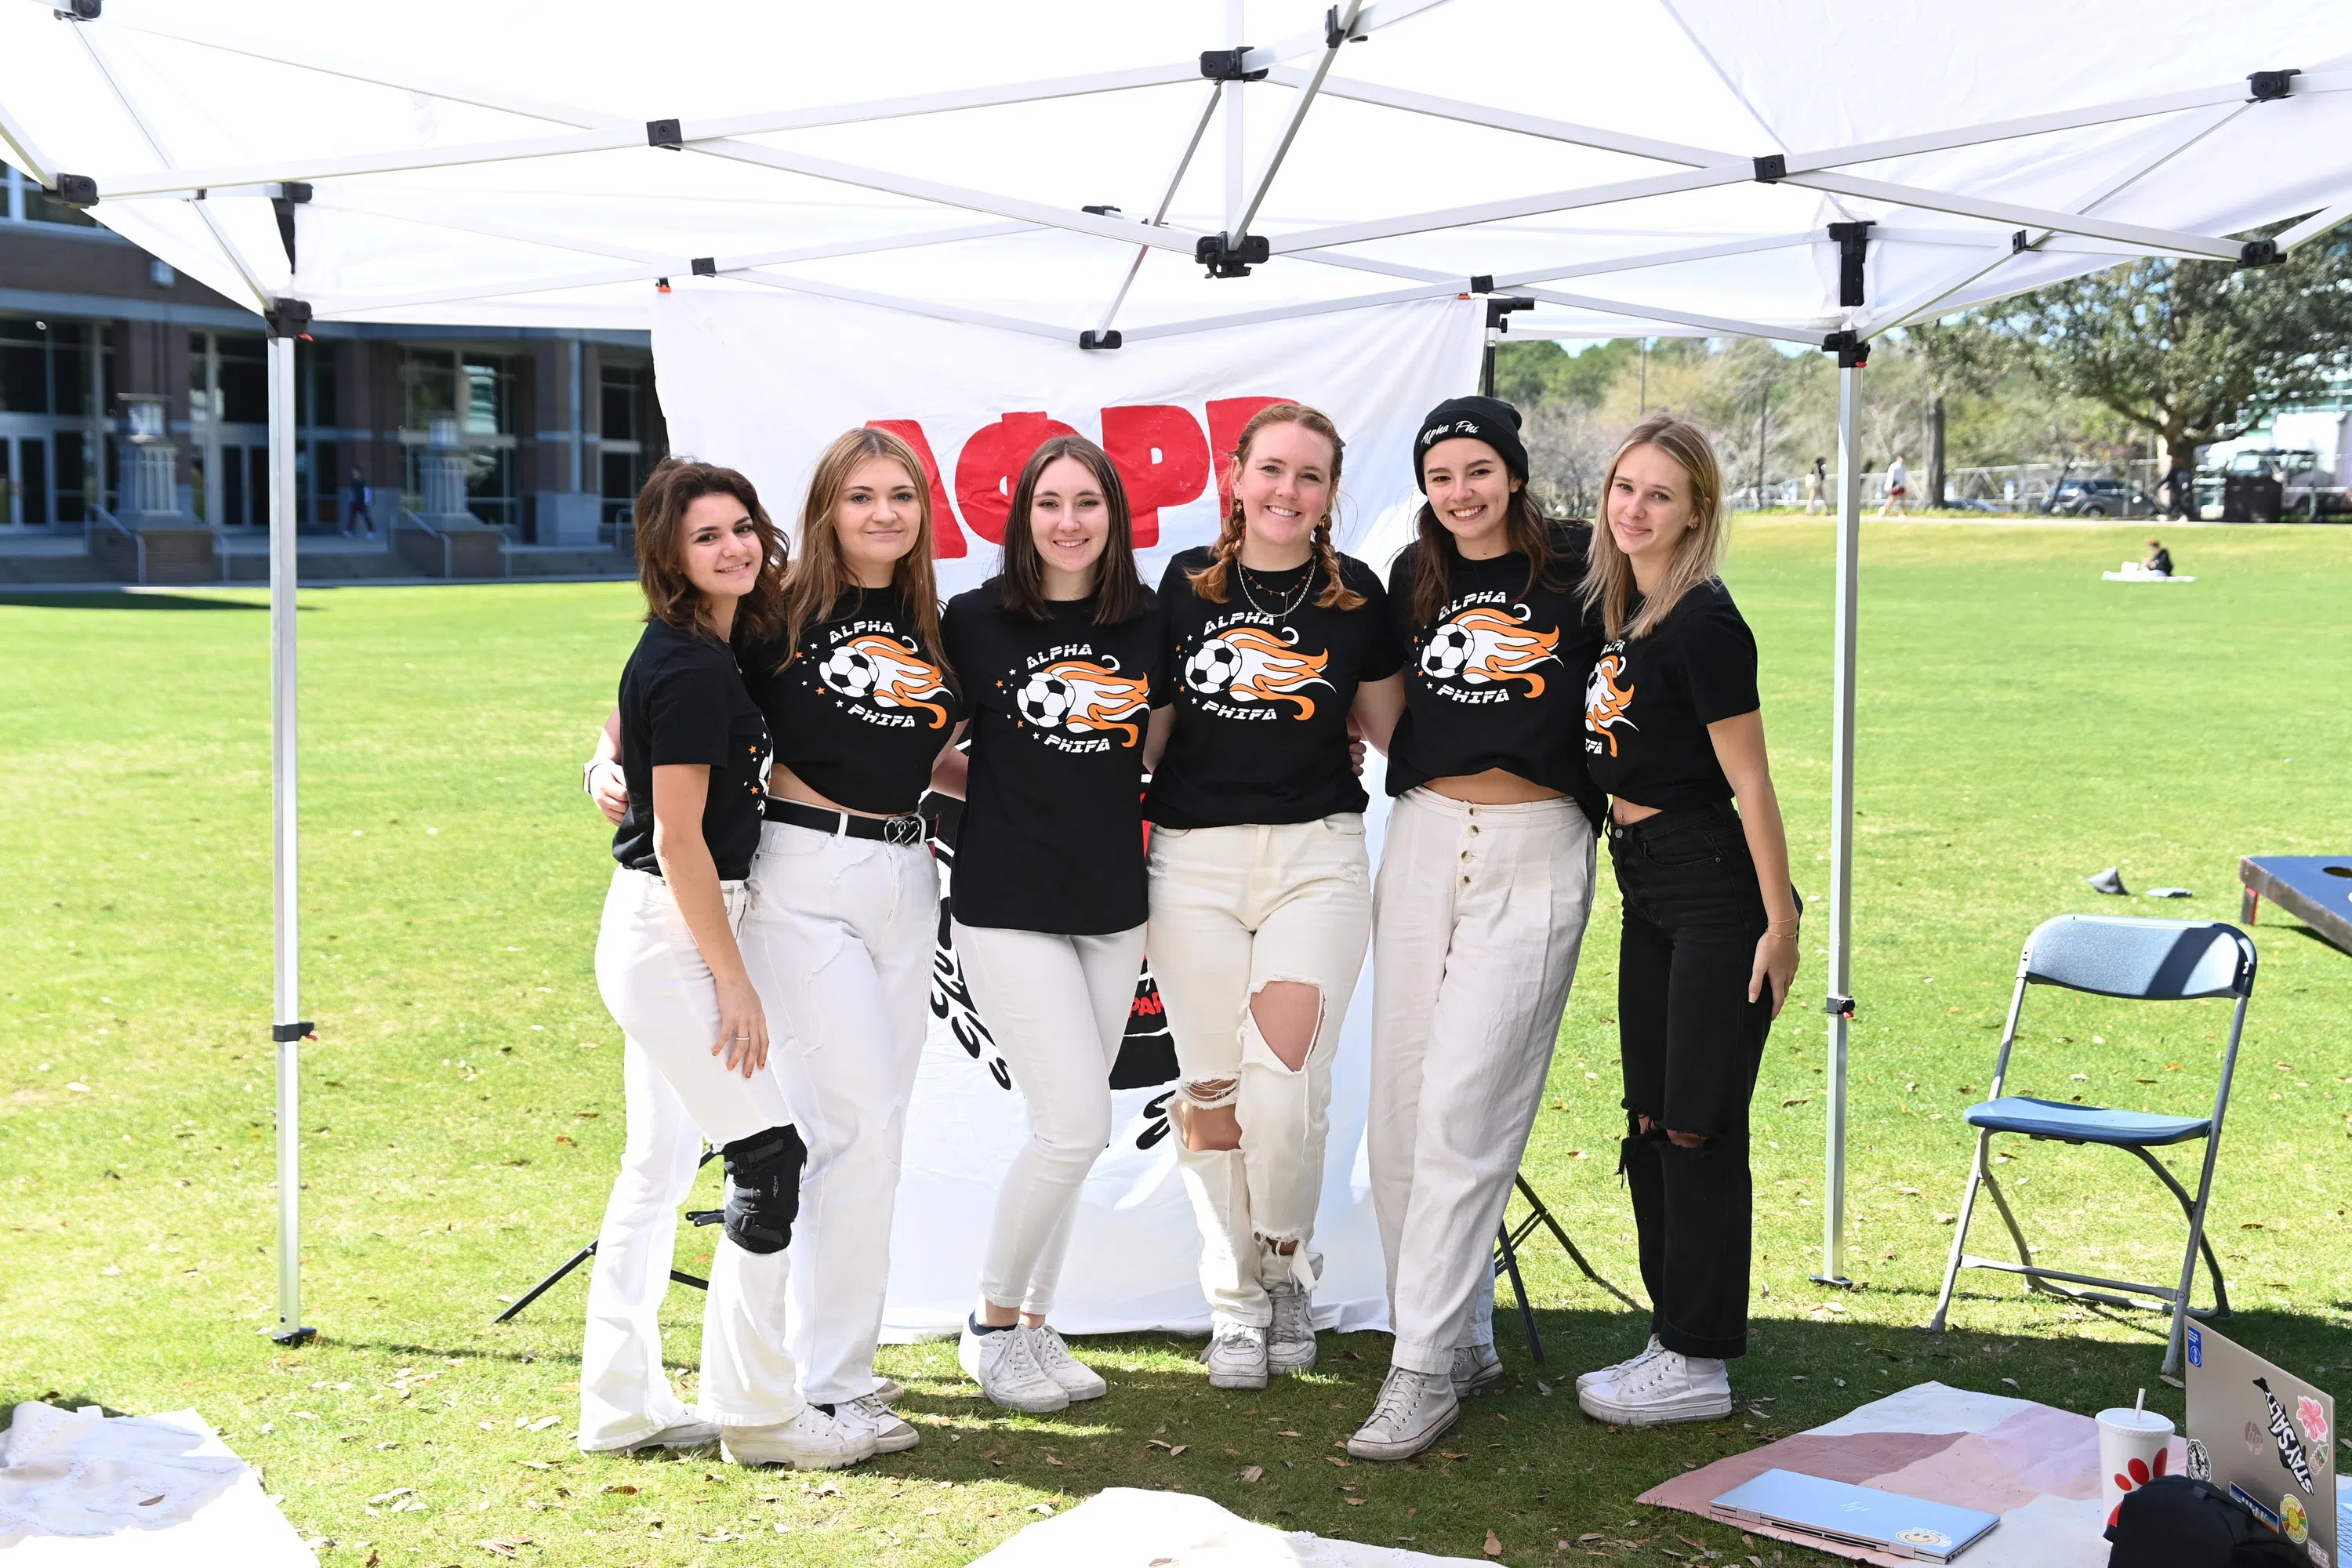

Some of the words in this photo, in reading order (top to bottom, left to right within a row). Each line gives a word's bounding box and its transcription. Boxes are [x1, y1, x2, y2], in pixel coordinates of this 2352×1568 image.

[1420, 424, 1450, 445] Alpha
[1455, 420, 1481, 434] Phi
[1439, 591, 1507, 622] ALPHA
[829, 621, 895, 644] ALPHA
[1204, 611, 1275, 637] ALPHA
[1027, 644, 1093, 670] ALPHA
[1437, 684, 1510, 705] PHIFA
[848, 704, 916, 727] PHIFA
[1202, 700, 1278, 720] PHIFA
[1044, 735, 1111, 753] PHIFA
[2307, 1541, 2328, 1563] rad
